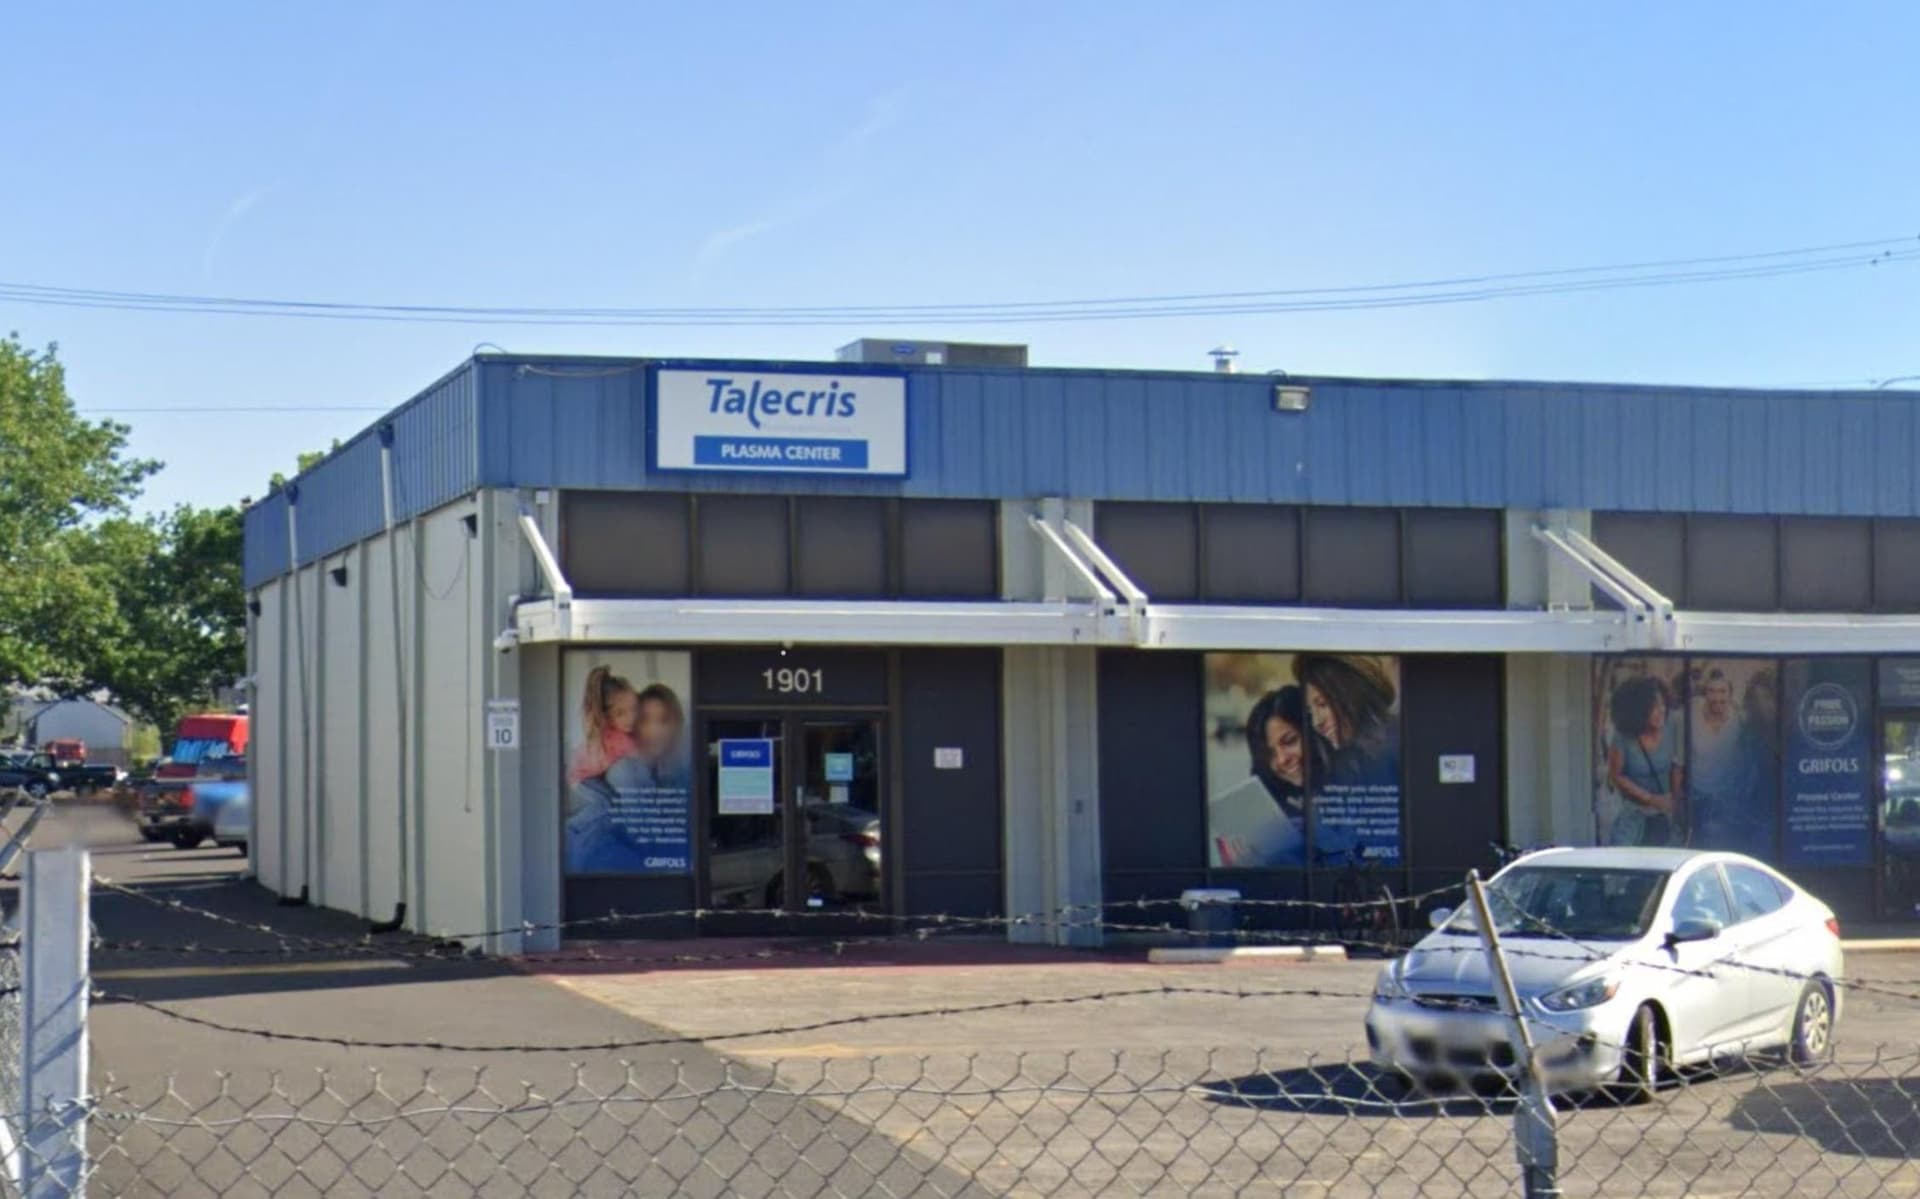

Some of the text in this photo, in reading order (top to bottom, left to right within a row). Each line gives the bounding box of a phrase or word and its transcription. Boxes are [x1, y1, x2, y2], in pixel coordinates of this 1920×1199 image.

[706, 379, 856, 430] Talecris
[721, 444, 841, 461] PLASMA CENTER
[762, 668, 823, 693] 1901
[495, 727, 513, 745] 10
[1798, 757, 1860, 775] GRIFOLS
